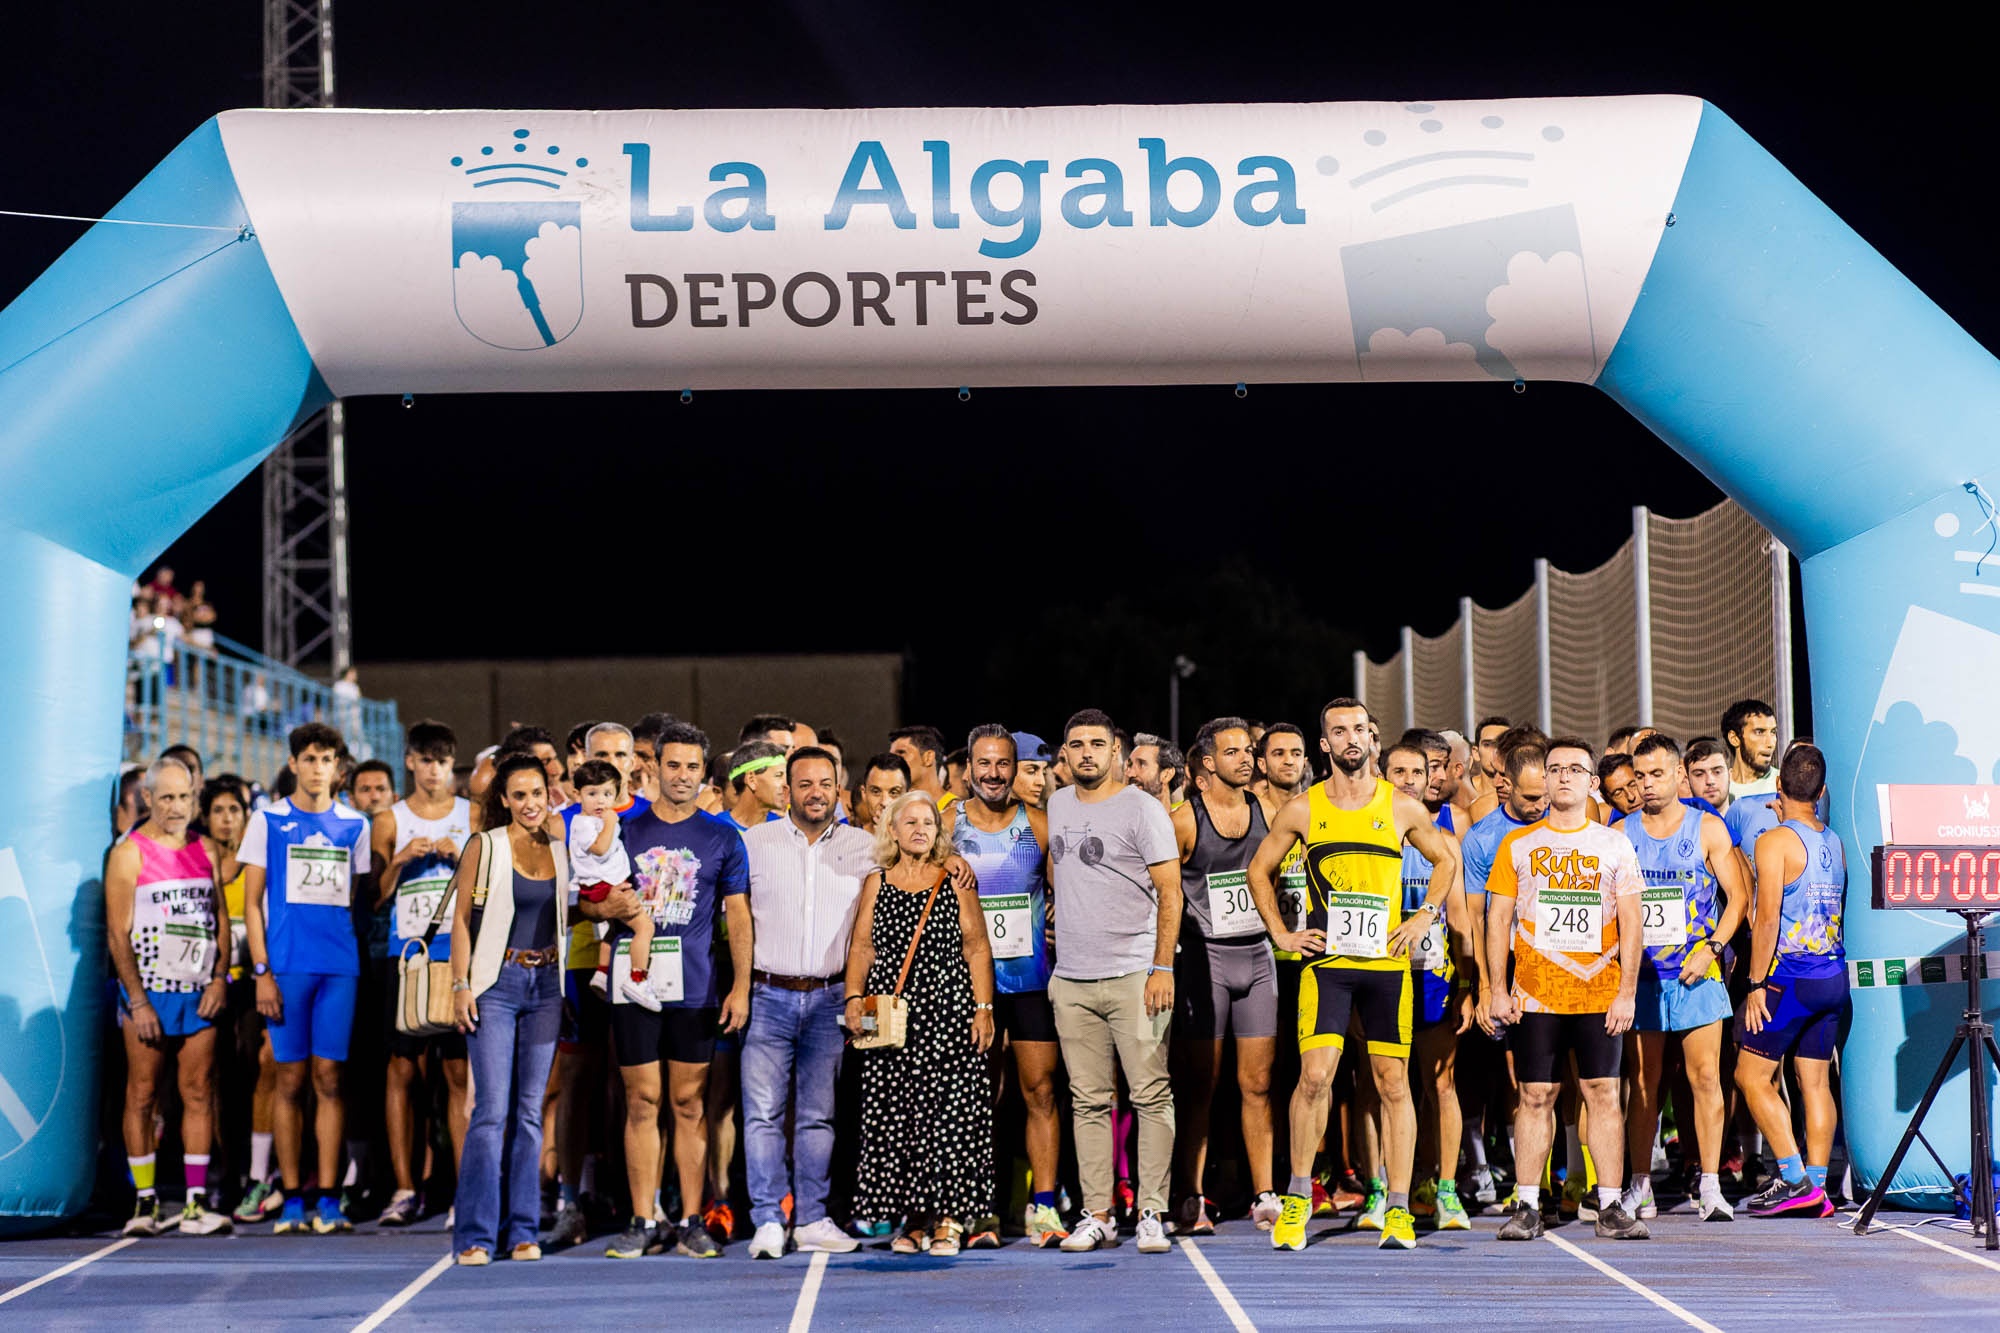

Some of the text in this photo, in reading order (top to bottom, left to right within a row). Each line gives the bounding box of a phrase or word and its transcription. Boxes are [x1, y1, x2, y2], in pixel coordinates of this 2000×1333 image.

[622, 137, 1307, 259] La Algaba
[624, 269, 1039, 328] DEPORTES
[302, 862, 337, 886] 234
[1529, 846, 1600, 878] Ruta
[1209, 877, 1242, 886] DIPUTACIÓN
[409, 895, 438, 918] 43
[1008, 899, 1030, 907] SEVILLA
[1336, 898, 1364, 906] PUTACIÓN
[1539, 893, 1571, 902] DIPUTACIÓN
[993, 913, 1006, 939] 8
[1341, 910, 1377, 938] 316
[1548, 907, 1589, 934] 248
[179, 940, 201, 964] 76
